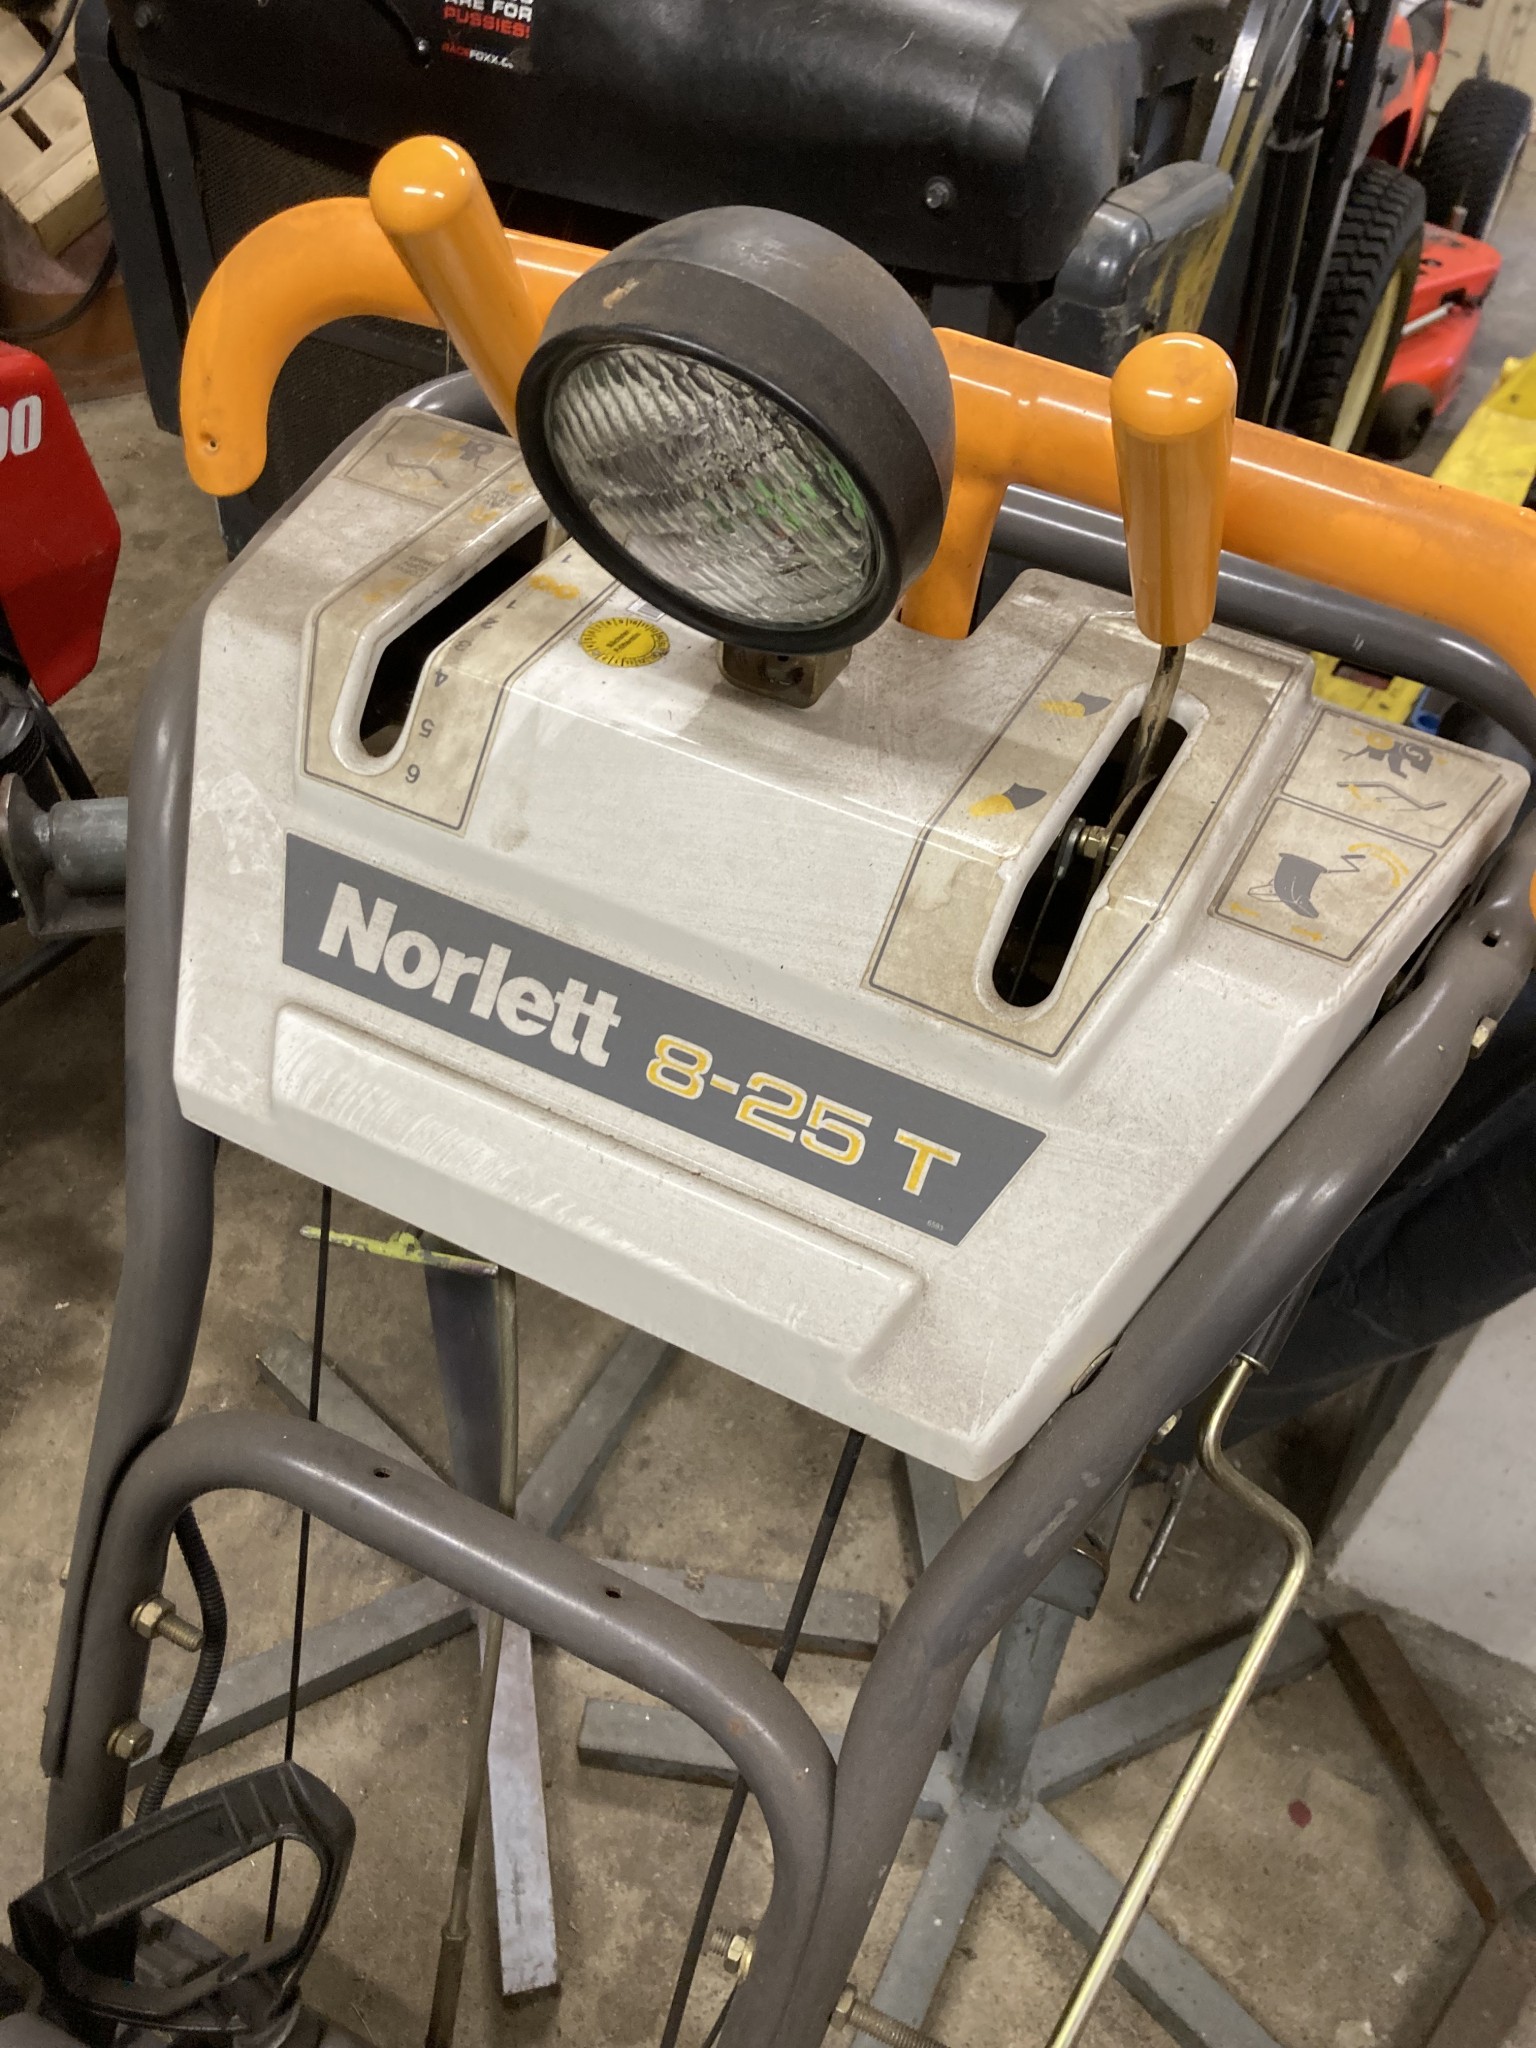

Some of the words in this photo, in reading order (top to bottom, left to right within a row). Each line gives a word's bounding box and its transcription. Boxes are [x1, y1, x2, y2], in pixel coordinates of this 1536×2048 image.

[492, 0, 533, 23] FOR
[443, 5, 531, 39] PUSSIES!
[481, 617, 499, 629] 2
[454, 639, 472, 651] 3
[434, 668, 448, 687] 4
[419, 718, 435, 738] 5
[405, 764, 420, 784] 6
[318, 881, 621, 1068] Norlett
[645, 1033, 873, 1167] 8-25
[894, 1128, 961, 1197] T
